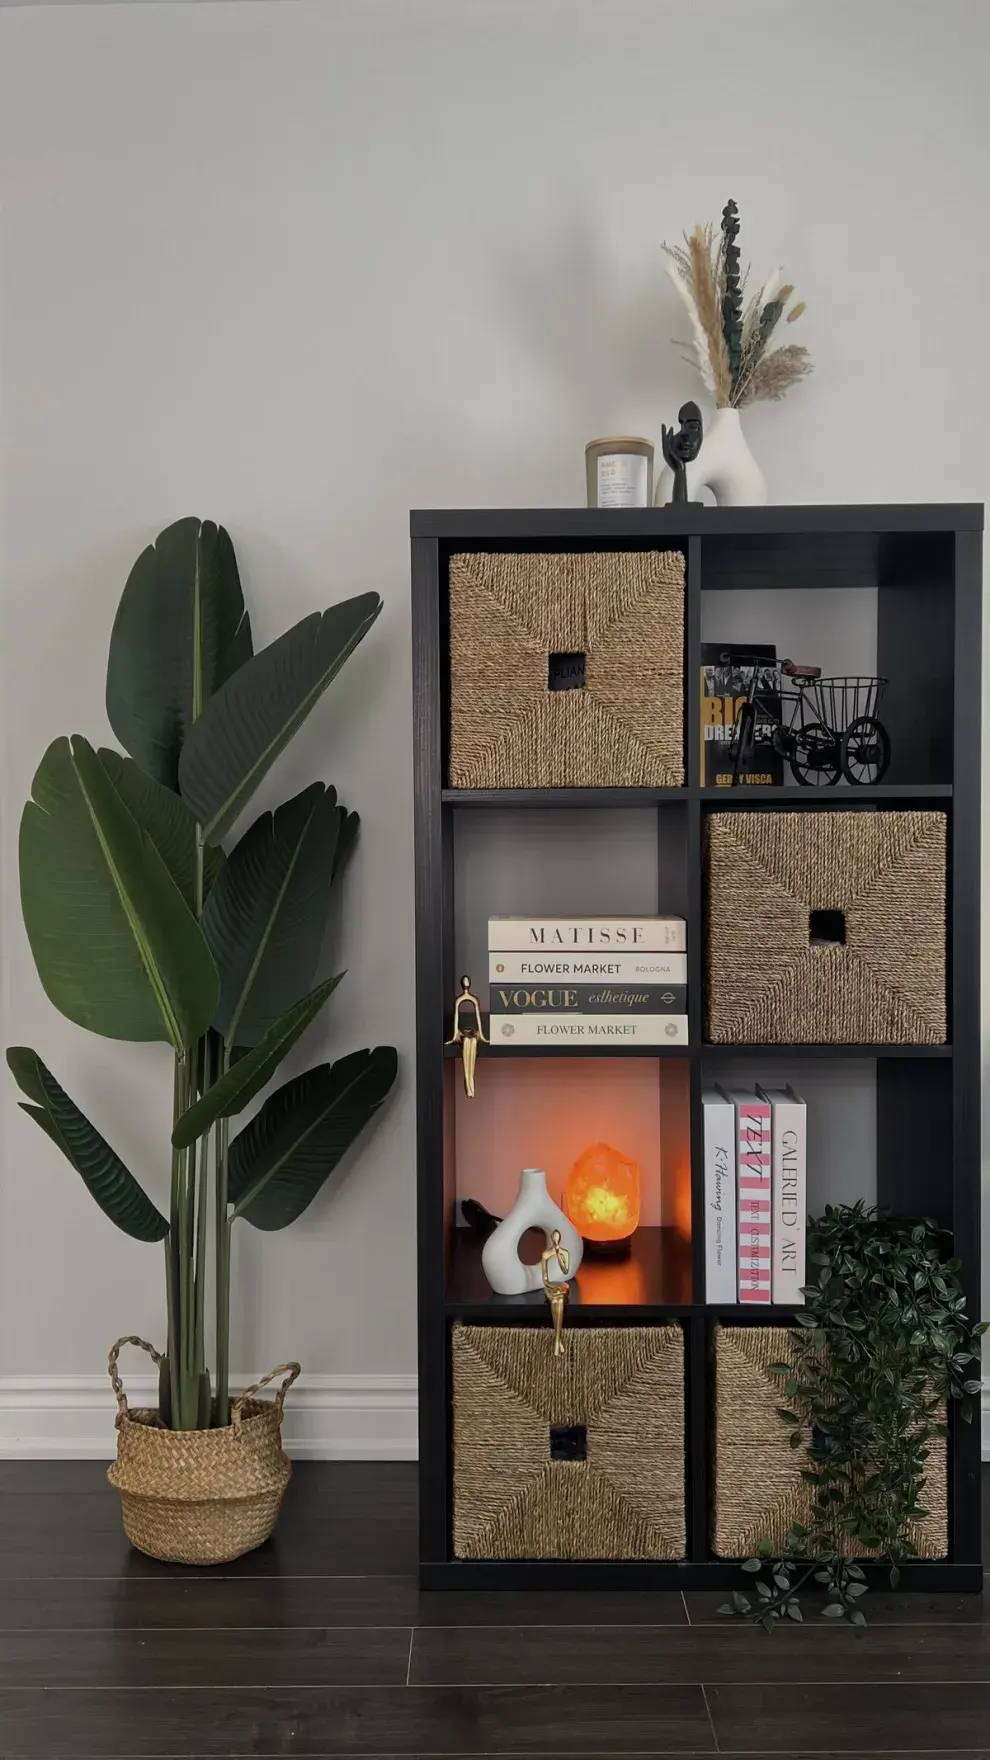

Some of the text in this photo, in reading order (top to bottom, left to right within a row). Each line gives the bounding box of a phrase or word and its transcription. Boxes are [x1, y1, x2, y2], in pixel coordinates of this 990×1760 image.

[716, 774, 772, 784] GERY VISCA
[529, 927, 645, 944] MATISSE
[521, 964, 622, 974] FLOWER MARKET
[499, 990, 579, 1008] VOGUE
[537, 1025, 638, 1035] FLOWER MARKET
[746, 1114, 763, 1182] TEXT
[781, 1130, 798, 1207] GALERIE
[750, 1200, 760, 1220] TEXT
[781, 1237, 797, 1276] ART
